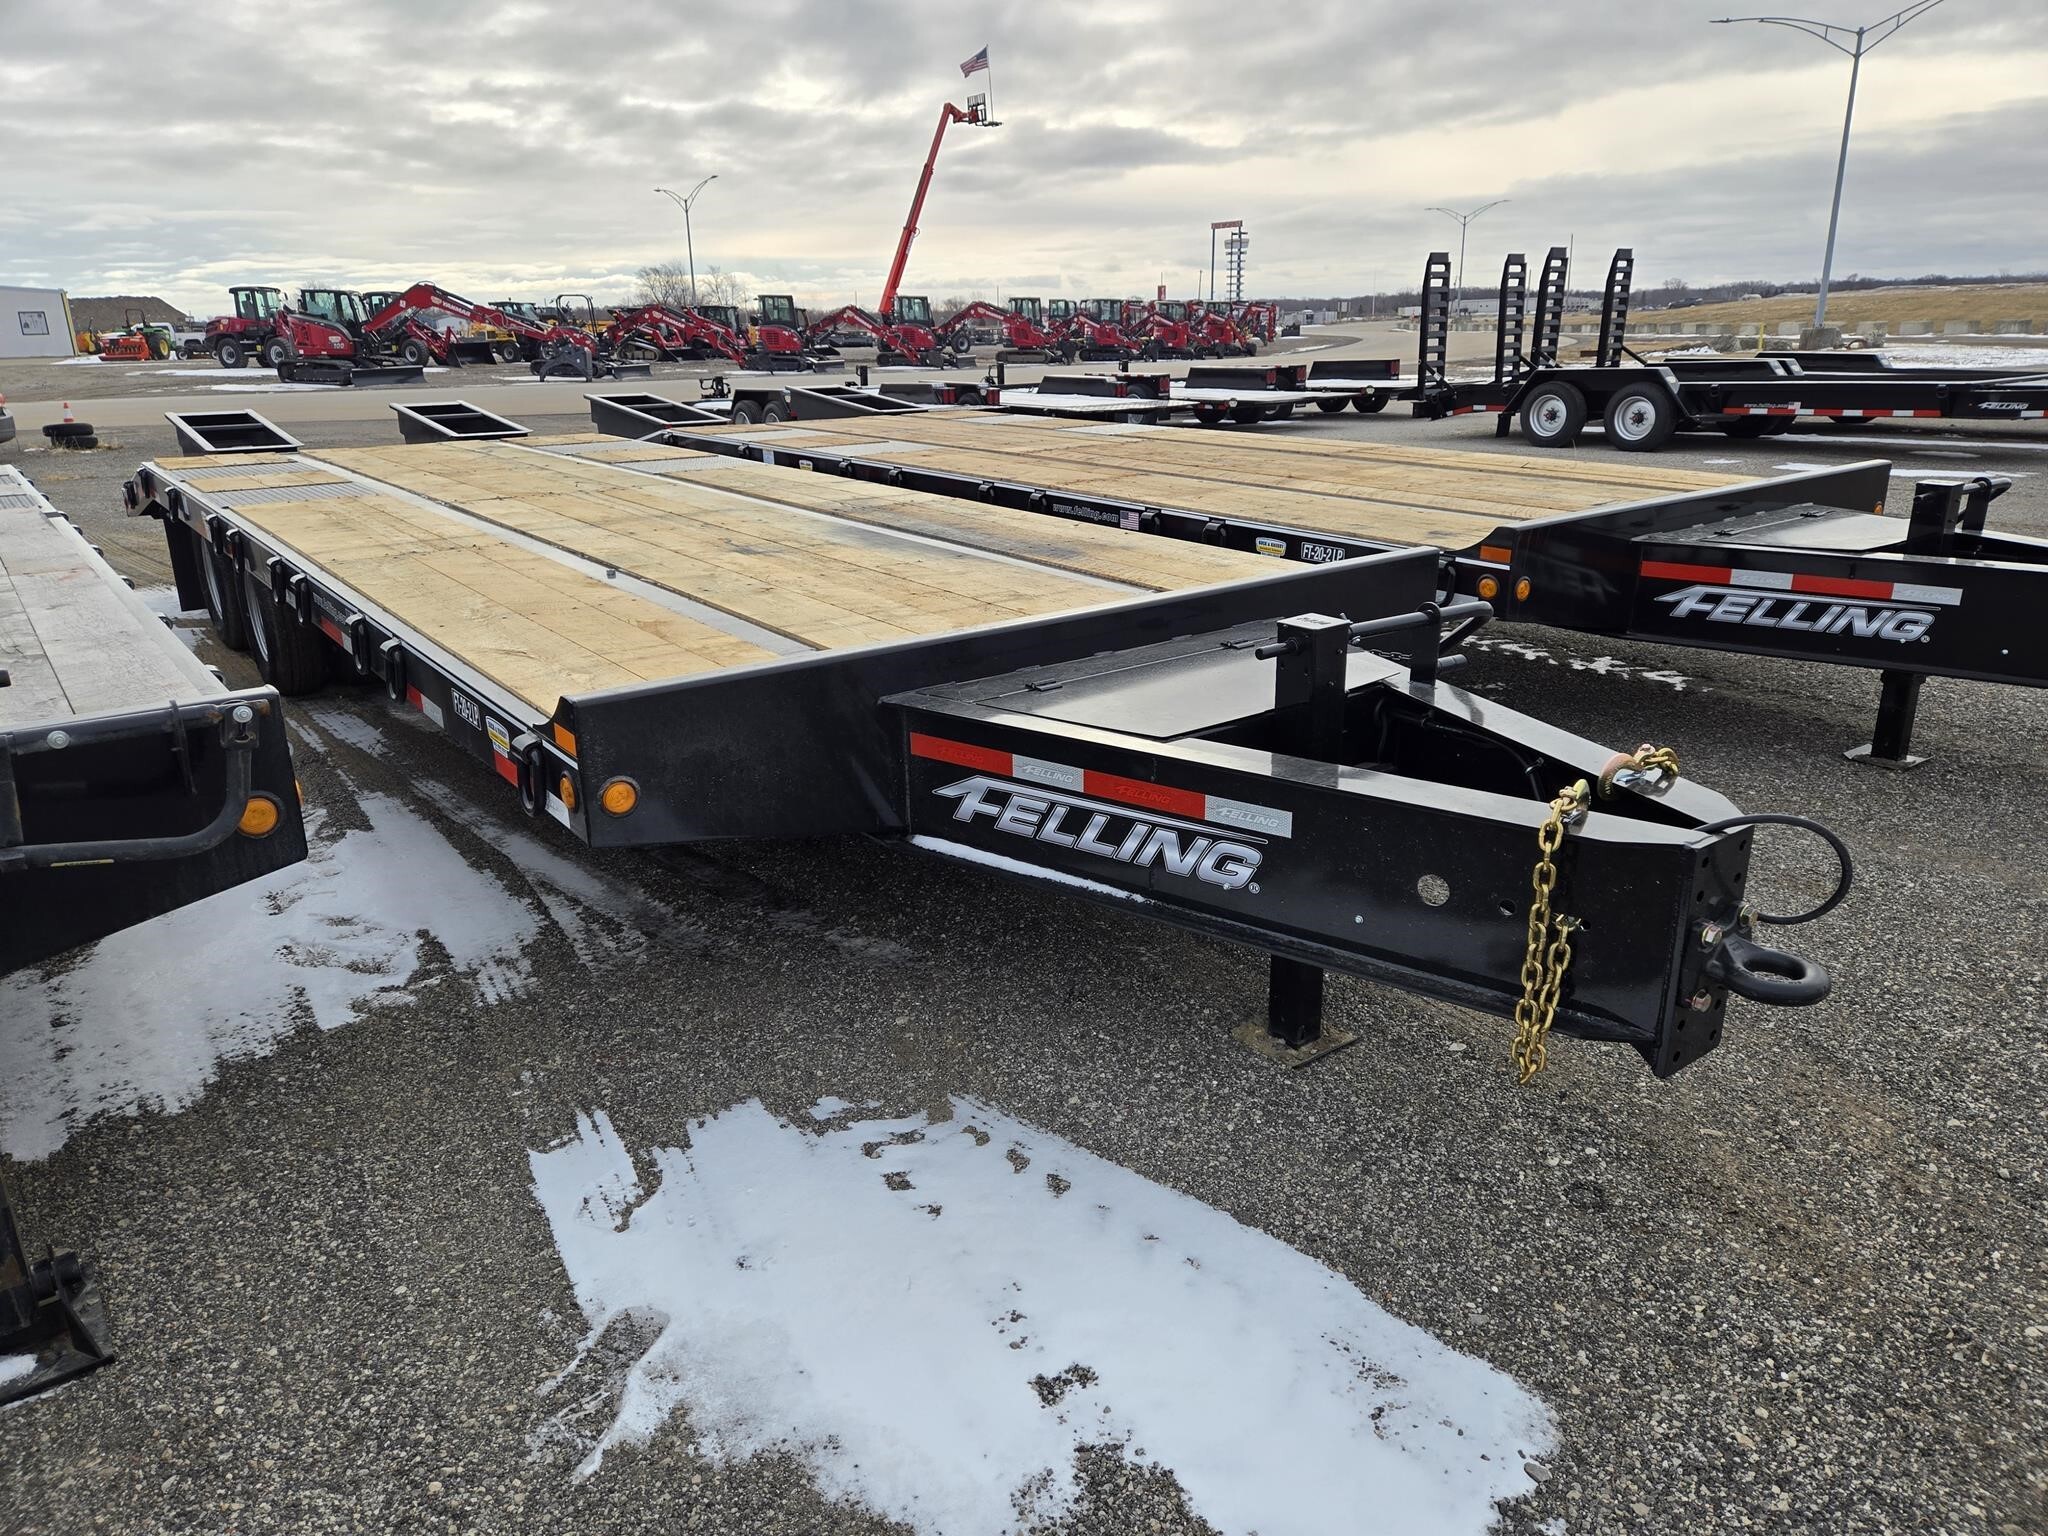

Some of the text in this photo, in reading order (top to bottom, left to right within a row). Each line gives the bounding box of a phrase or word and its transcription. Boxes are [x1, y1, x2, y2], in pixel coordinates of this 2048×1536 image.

[442, 300, 471, 317] YANMAR
[1978, 401, 2029, 410] FELLING
[1052, 503, 1119, 523] www.felling.com
[1303, 544, 1332, 562] FT-20-2
[1653, 584, 1941, 643] FELLING
[1021, 763, 1074, 784] FELLING
[1114, 784, 1172, 805] FELLING
[1217, 807, 1280, 828] FELLING
[931, 774, 1269, 891] FELLING
